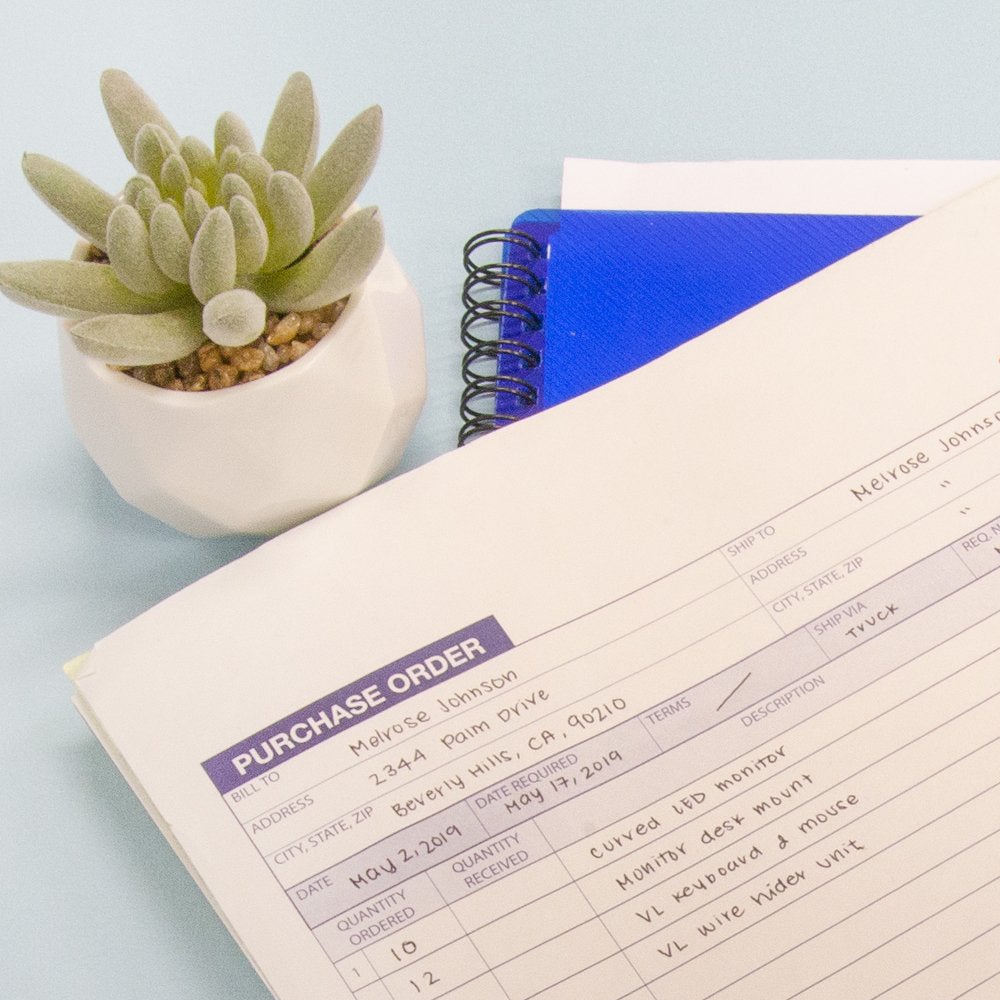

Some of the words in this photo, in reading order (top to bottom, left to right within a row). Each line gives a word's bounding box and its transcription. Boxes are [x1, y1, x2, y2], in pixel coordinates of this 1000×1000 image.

[849, 451, 930, 502] Melrose
[727, 533, 756, 558] SHIP
[755, 524, 776, 545] TO
[749, 546, 808, 586] ADDRESS
[772, 590, 803, 614] CITY,
[802, 567, 845, 597] STATE,
[843, 555, 864, 574] ZIP
[813, 611, 843, 637] SHIP
[843, 600, 868, 620] VIA
[231, 684, 387, 776] PURCHASE
[387, 637, 488, 694] ORDER
[349, 709, 431, 757] Melrose
[437, 669, 518, 713] Johnson
[647, 696, 692, 726] TERMS
[740, 674, 826, 728] DESCRIPTION
[368, 748, 428, 786] 2344
[497, 688, 550, 723] Drive
[391, 773, 466, 818] Beverly
[467, 749, 520, 778] Hills,
[567, 697, 627, 731] 90210
[230, 781, 261, 804] BILL
[261, 770, 281, 789] TO
[474, 787, 513, 810] DATE
[511, 752, 579, 793] REQUIRED
[504, 786, 545, 815] May
[580, 749, 623, 781] 2019
[714, 745, 787, 792] monitor
[251, 794, 315, 835] ADDRESS
[752, 773, 814, 816] mount
[273, 842, 309, 866] CITY,
[307, 819, 353, 848] STATE,
[353, 805, 374, 825] ZIP
[451, 831, 522, 875] QUANTITY
[348, 858, 398, 890] May
[463, 849, 530, 889] RECEIVED
[635, 905, 665, 924] VL
[798, 793, 860, 834] mouse
[295, 874, 335, 902] DATE
[336, 888, 409, 933] QUANTITY
[348, 906, 416, 947] ORDERED
[389, 940, 417, 963] 10
[657, 940, 689, 960] VL
[409, 971, 441, 993] 12
